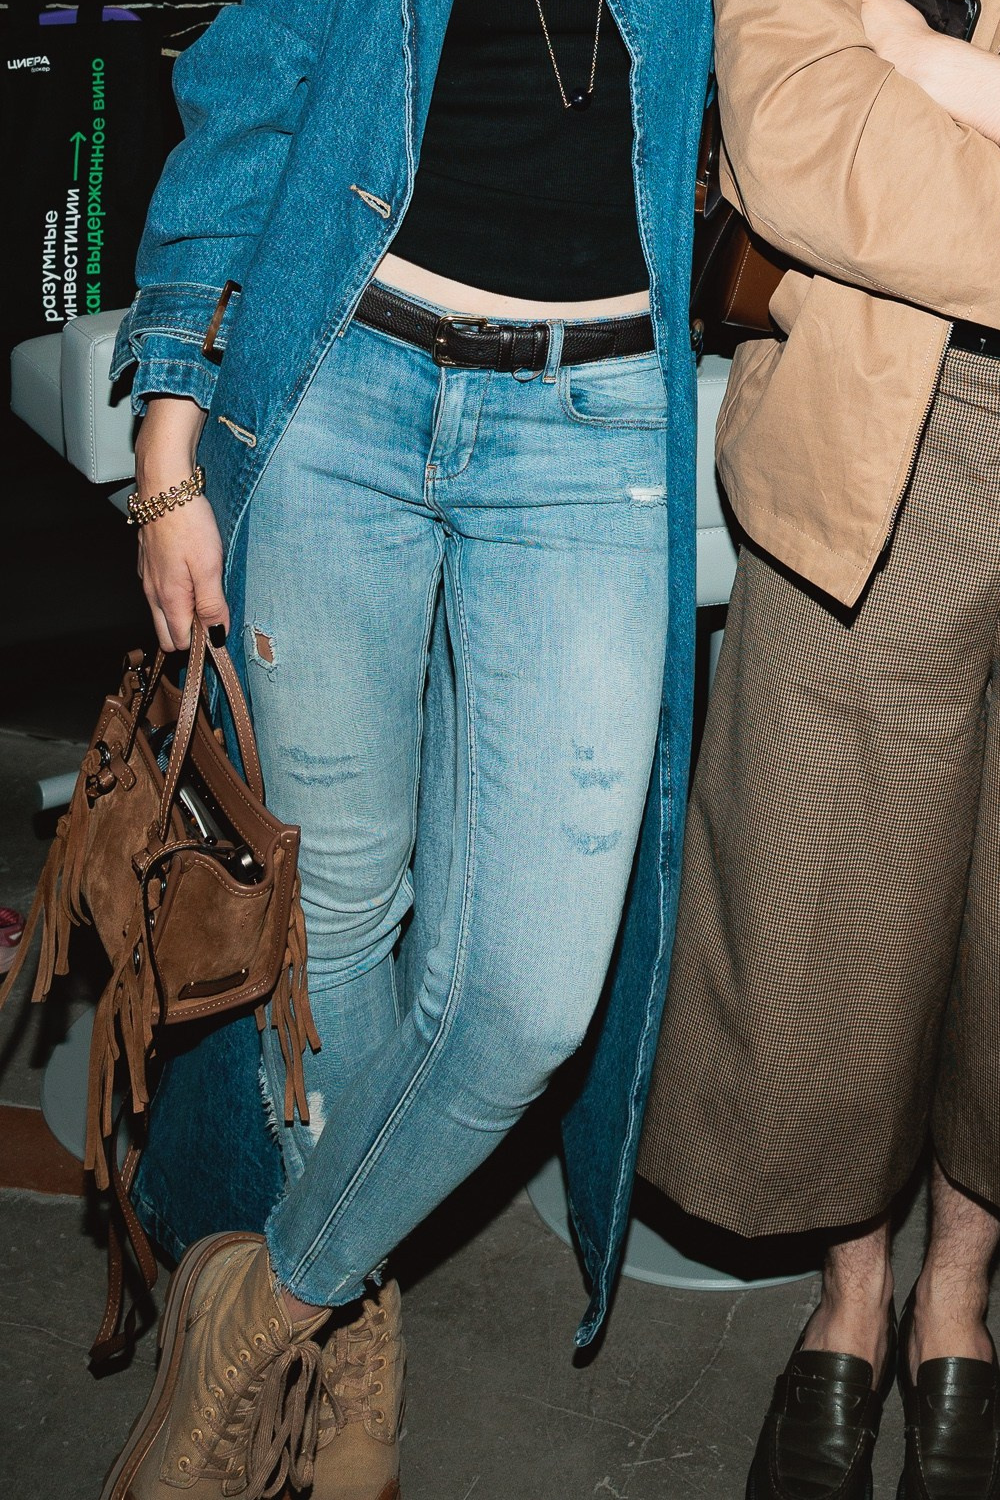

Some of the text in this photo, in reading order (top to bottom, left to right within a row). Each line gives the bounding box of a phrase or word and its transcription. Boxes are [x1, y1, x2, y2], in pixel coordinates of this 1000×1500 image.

[90, 57, 105, 111] вино
[63, 187, 82, 324] инвестиции
[86, 117, 106, 275] выдержанное
[42, 210, 63, 322] разумные
